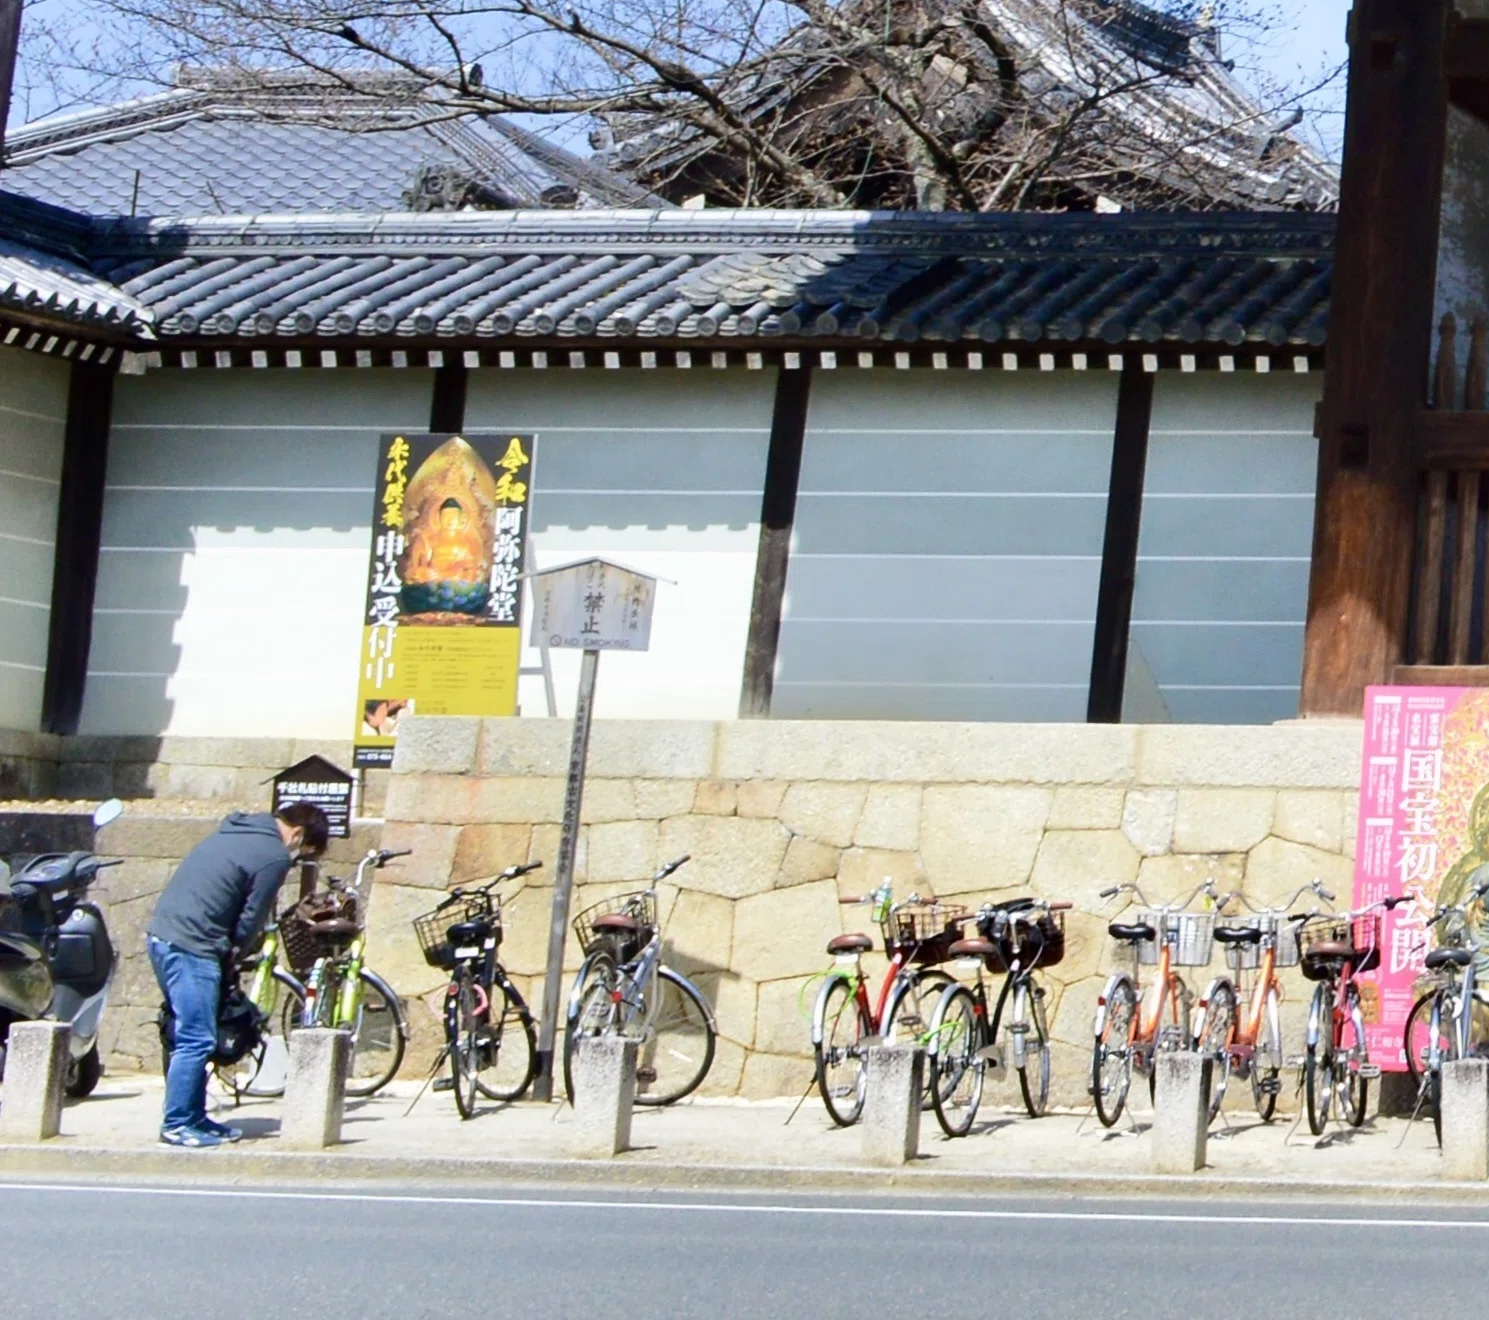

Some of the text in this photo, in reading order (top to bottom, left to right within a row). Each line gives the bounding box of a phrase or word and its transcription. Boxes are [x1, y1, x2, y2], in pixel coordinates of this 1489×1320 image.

[1389, 747, 1444, 975] 国宝初公開
